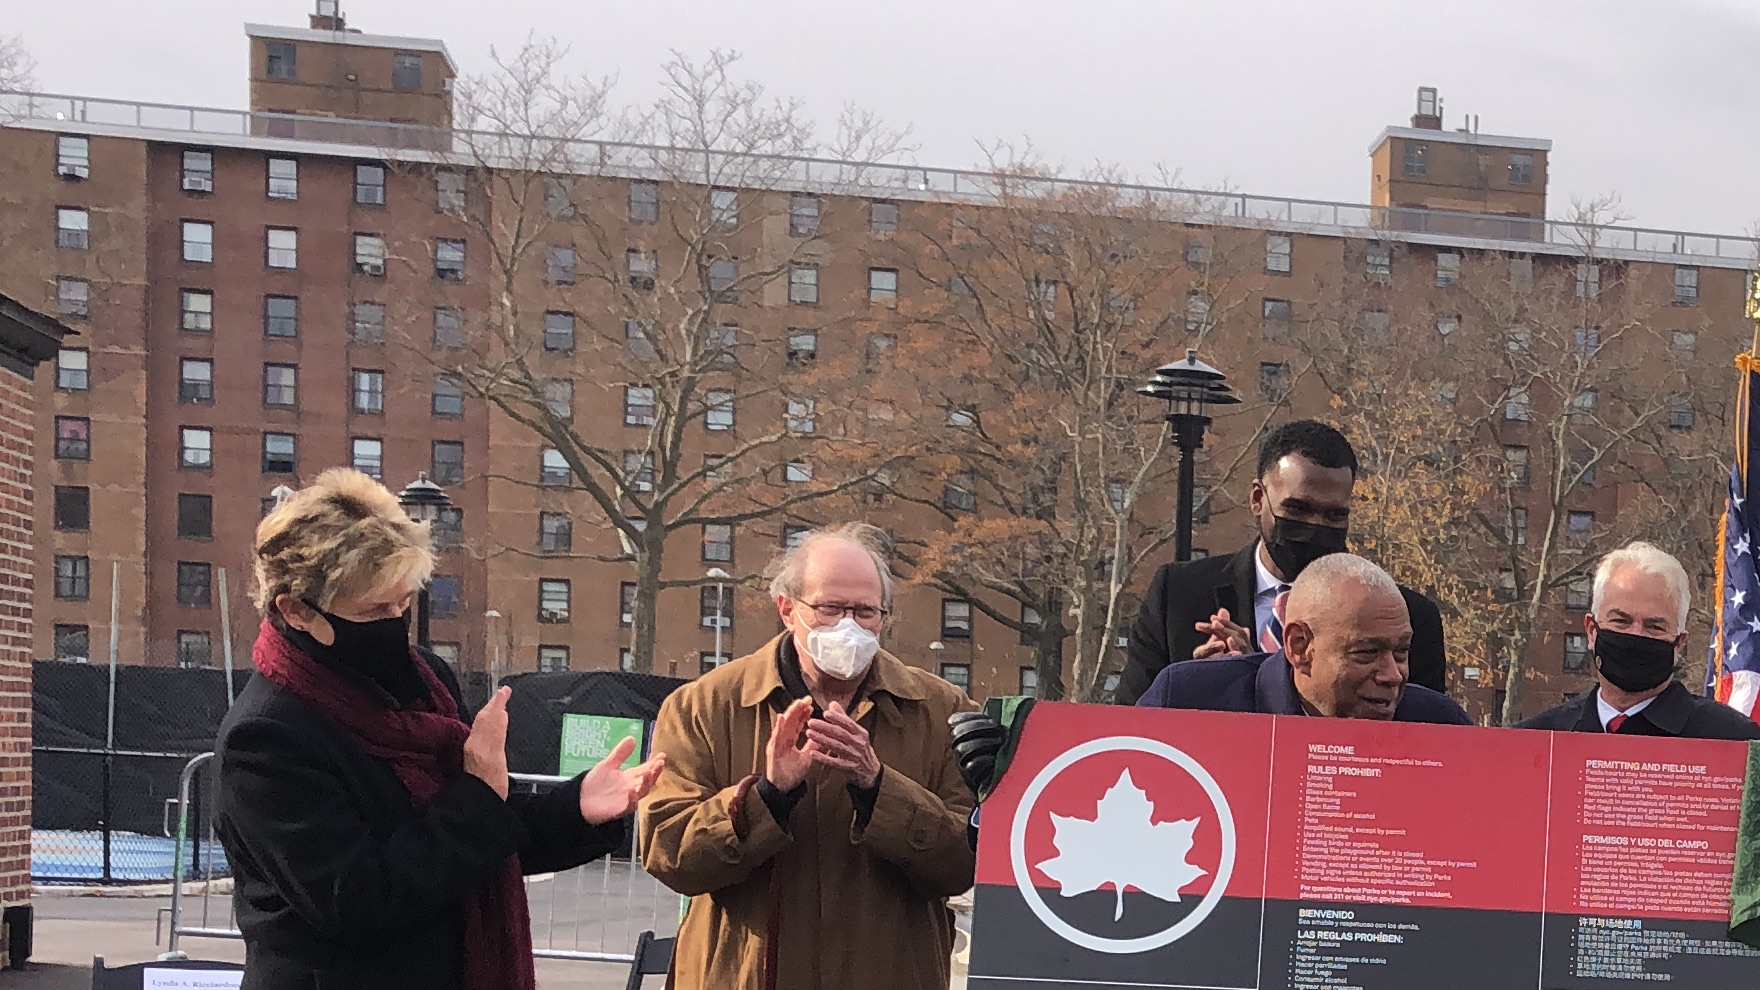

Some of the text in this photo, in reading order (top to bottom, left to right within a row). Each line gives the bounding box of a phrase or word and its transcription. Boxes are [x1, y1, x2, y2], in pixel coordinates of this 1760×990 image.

[567, 718, 611, 731] BUILD A
[565, 736, 605, 748] GREEN
[1308, 743, 1354, 754] WELCOME
[1307, 764, 1381, 777] RULES PROHIBIT:
[1585, 759, 1706, 774] PERMITTING AND FIELD USE
[1582, 834, 1708, 849] PERMISOS Y USO DEL CAMPO
[1298, 908, 1354, 919] BIENVENIDO
[1297, 930, 1403, 943] LAS REGLAS PROHÍBEN:
